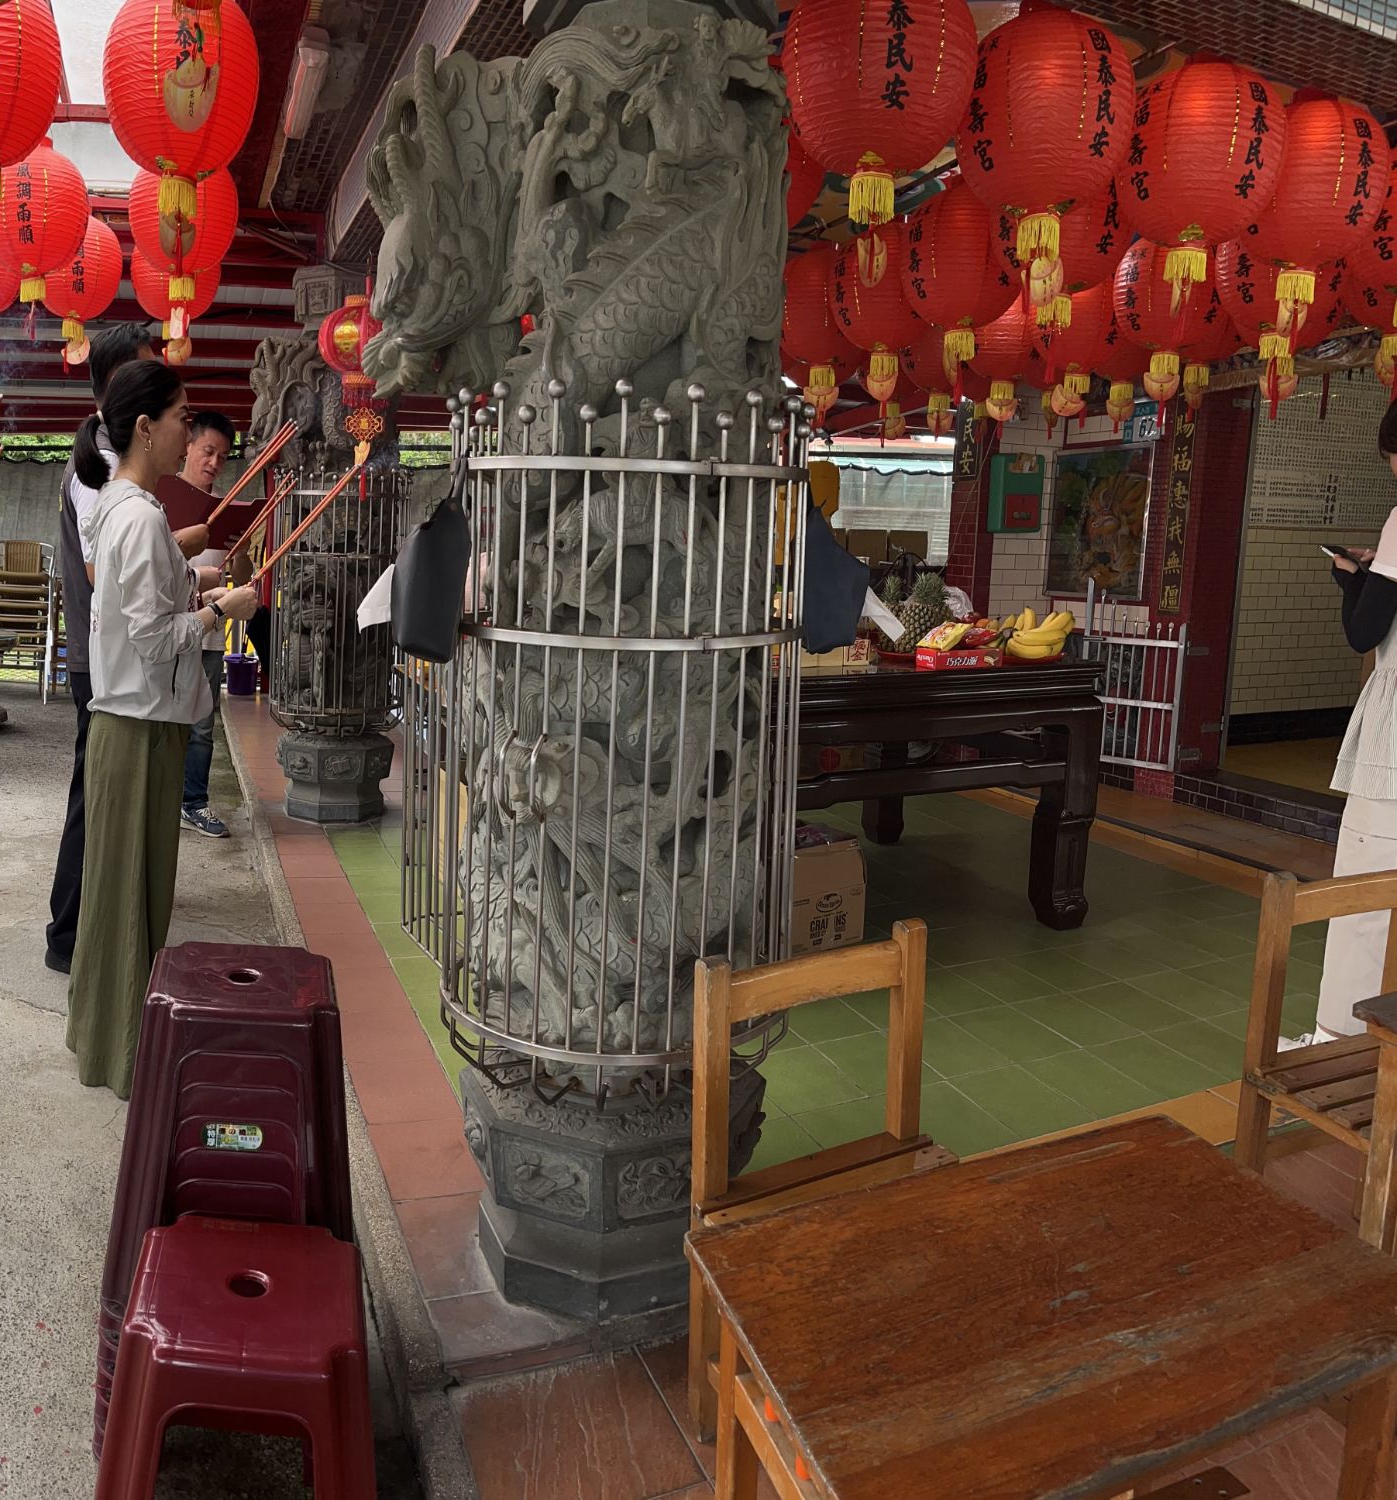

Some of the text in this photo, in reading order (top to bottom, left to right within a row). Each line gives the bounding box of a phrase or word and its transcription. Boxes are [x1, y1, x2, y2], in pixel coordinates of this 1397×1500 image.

[880, 0, 915, 110] 泰民安
[1087, 28, 1116, 158] 國泰民安
[1235, 81, 1269, 199] 國泰民安
[1344, 118, 1374, 226] 國泰民安
[16, 163, 34, 245] 風調雨順
[1373, 187, 1395, 261] 壽宮
[810, 913, 846, 932] CRAIINS
